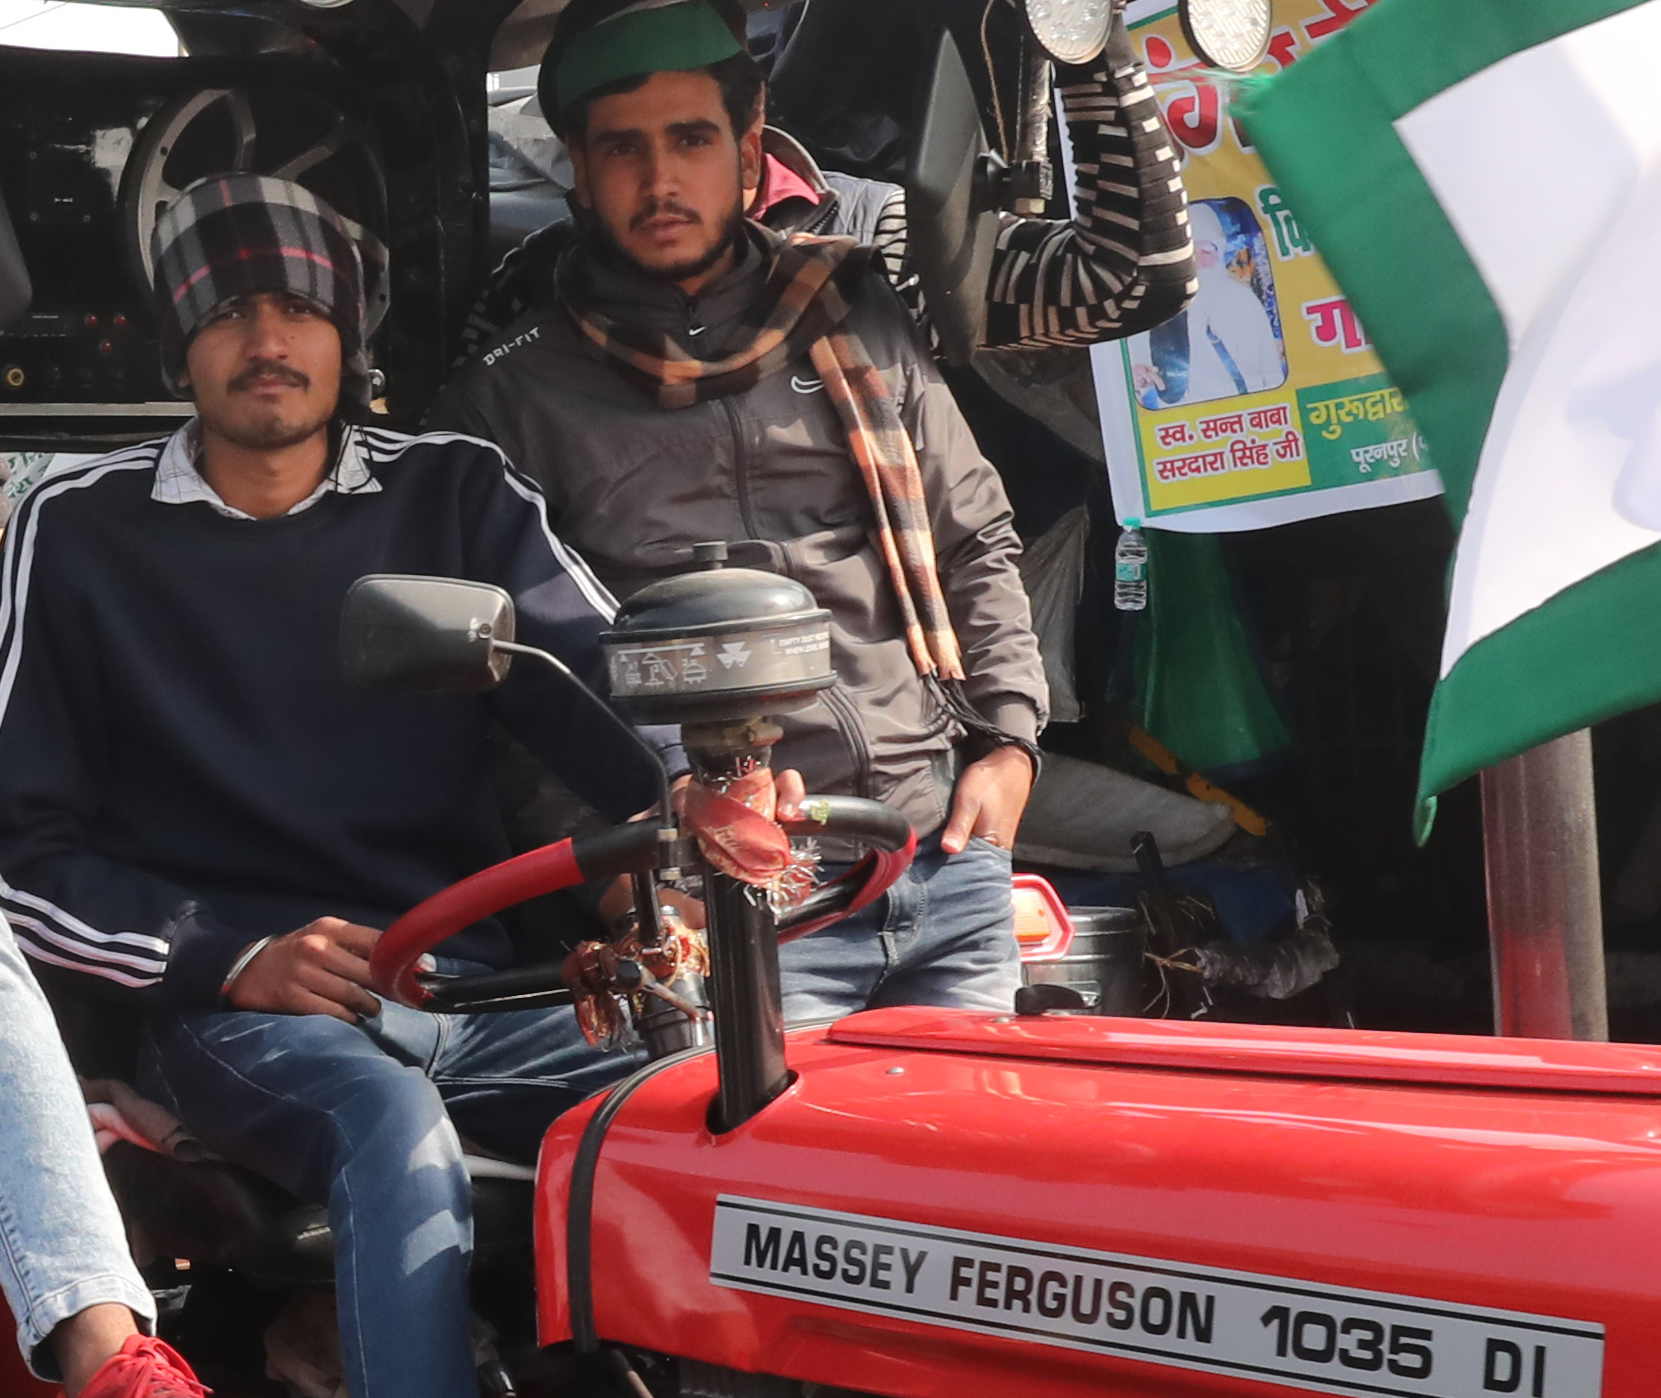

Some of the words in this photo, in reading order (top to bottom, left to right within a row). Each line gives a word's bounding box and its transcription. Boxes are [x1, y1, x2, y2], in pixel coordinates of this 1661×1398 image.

[483, 327, 540, 366] DRI-FIT
[1158, 423, 1195, 446] स्व.
[1200, 415, 1245, 439] सन्त
[1249, 405, 1289, 430] बाबा
[1156, 450, 1226, 480] सरदारा
[1230, 438, 1269, 468] सिंह
[1275, 431, 1303, 459] जी
[742, 1222, 930, 1296] MASSEY
[948, 1255, 1216, 1345] FERGUSON
[1259, 1304, 1434, 1382] 1035
